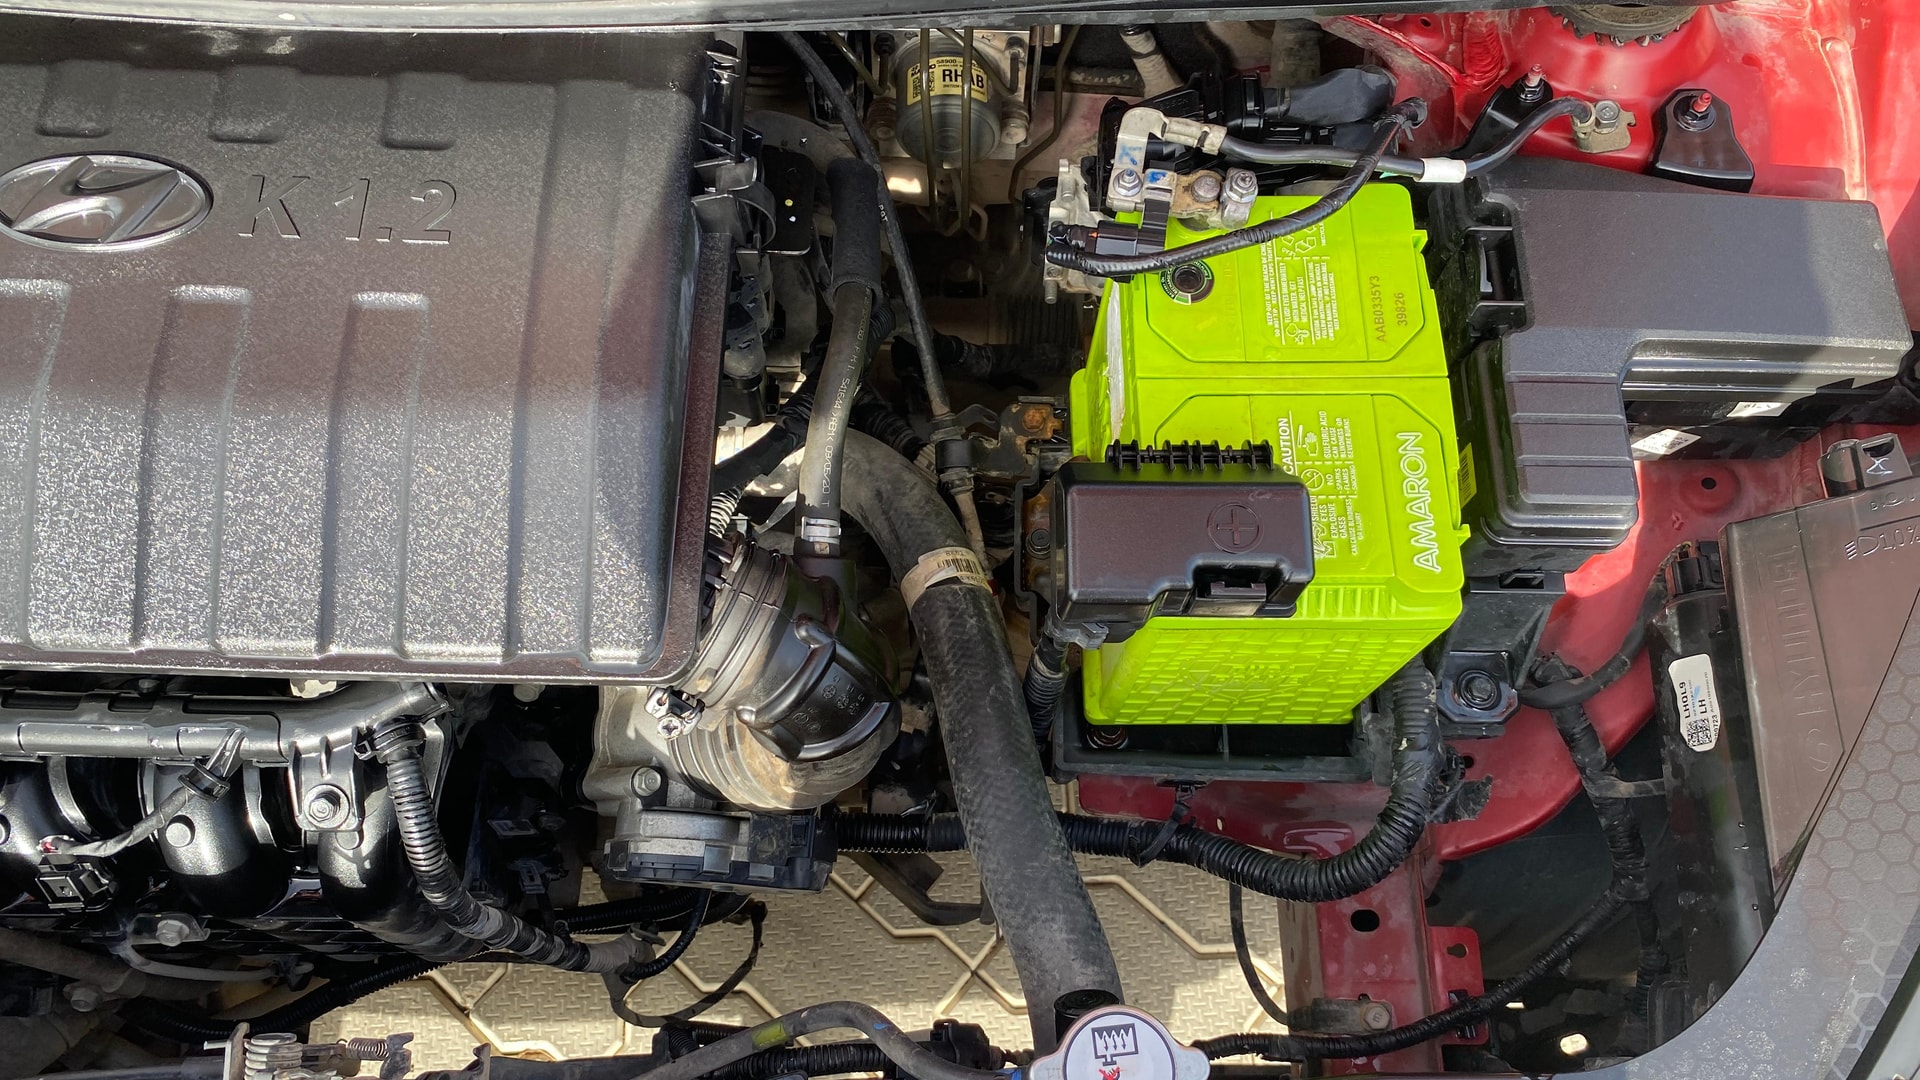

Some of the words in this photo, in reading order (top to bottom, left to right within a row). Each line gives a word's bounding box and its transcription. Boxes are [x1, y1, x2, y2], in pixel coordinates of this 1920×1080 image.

[238, 174, 310, 239] K
[333, 177, 457, 245] 1.2
[1369, 275, 1387, 343] AAB0335Y3
[1395, 293, 1407, 327] 39826
[1318, 410, 1327, 425] ACID
[1277, 417, 1294, 475] CAUTION
[1321, 426, 1330, 457] SULFURIC
[1337, 428, 1346, 457] BLINDNESS
[1325, 473, 1333, 485] NO
[1318, 504, 1327, 521] EYES
[1396, 432, 1442, 574] AMARON
[1327, 502, 1338, 538] EXPLOSIVE
[1337, 516, 1346, 538] GASES
[1697, 699, 1707, 713] LH
